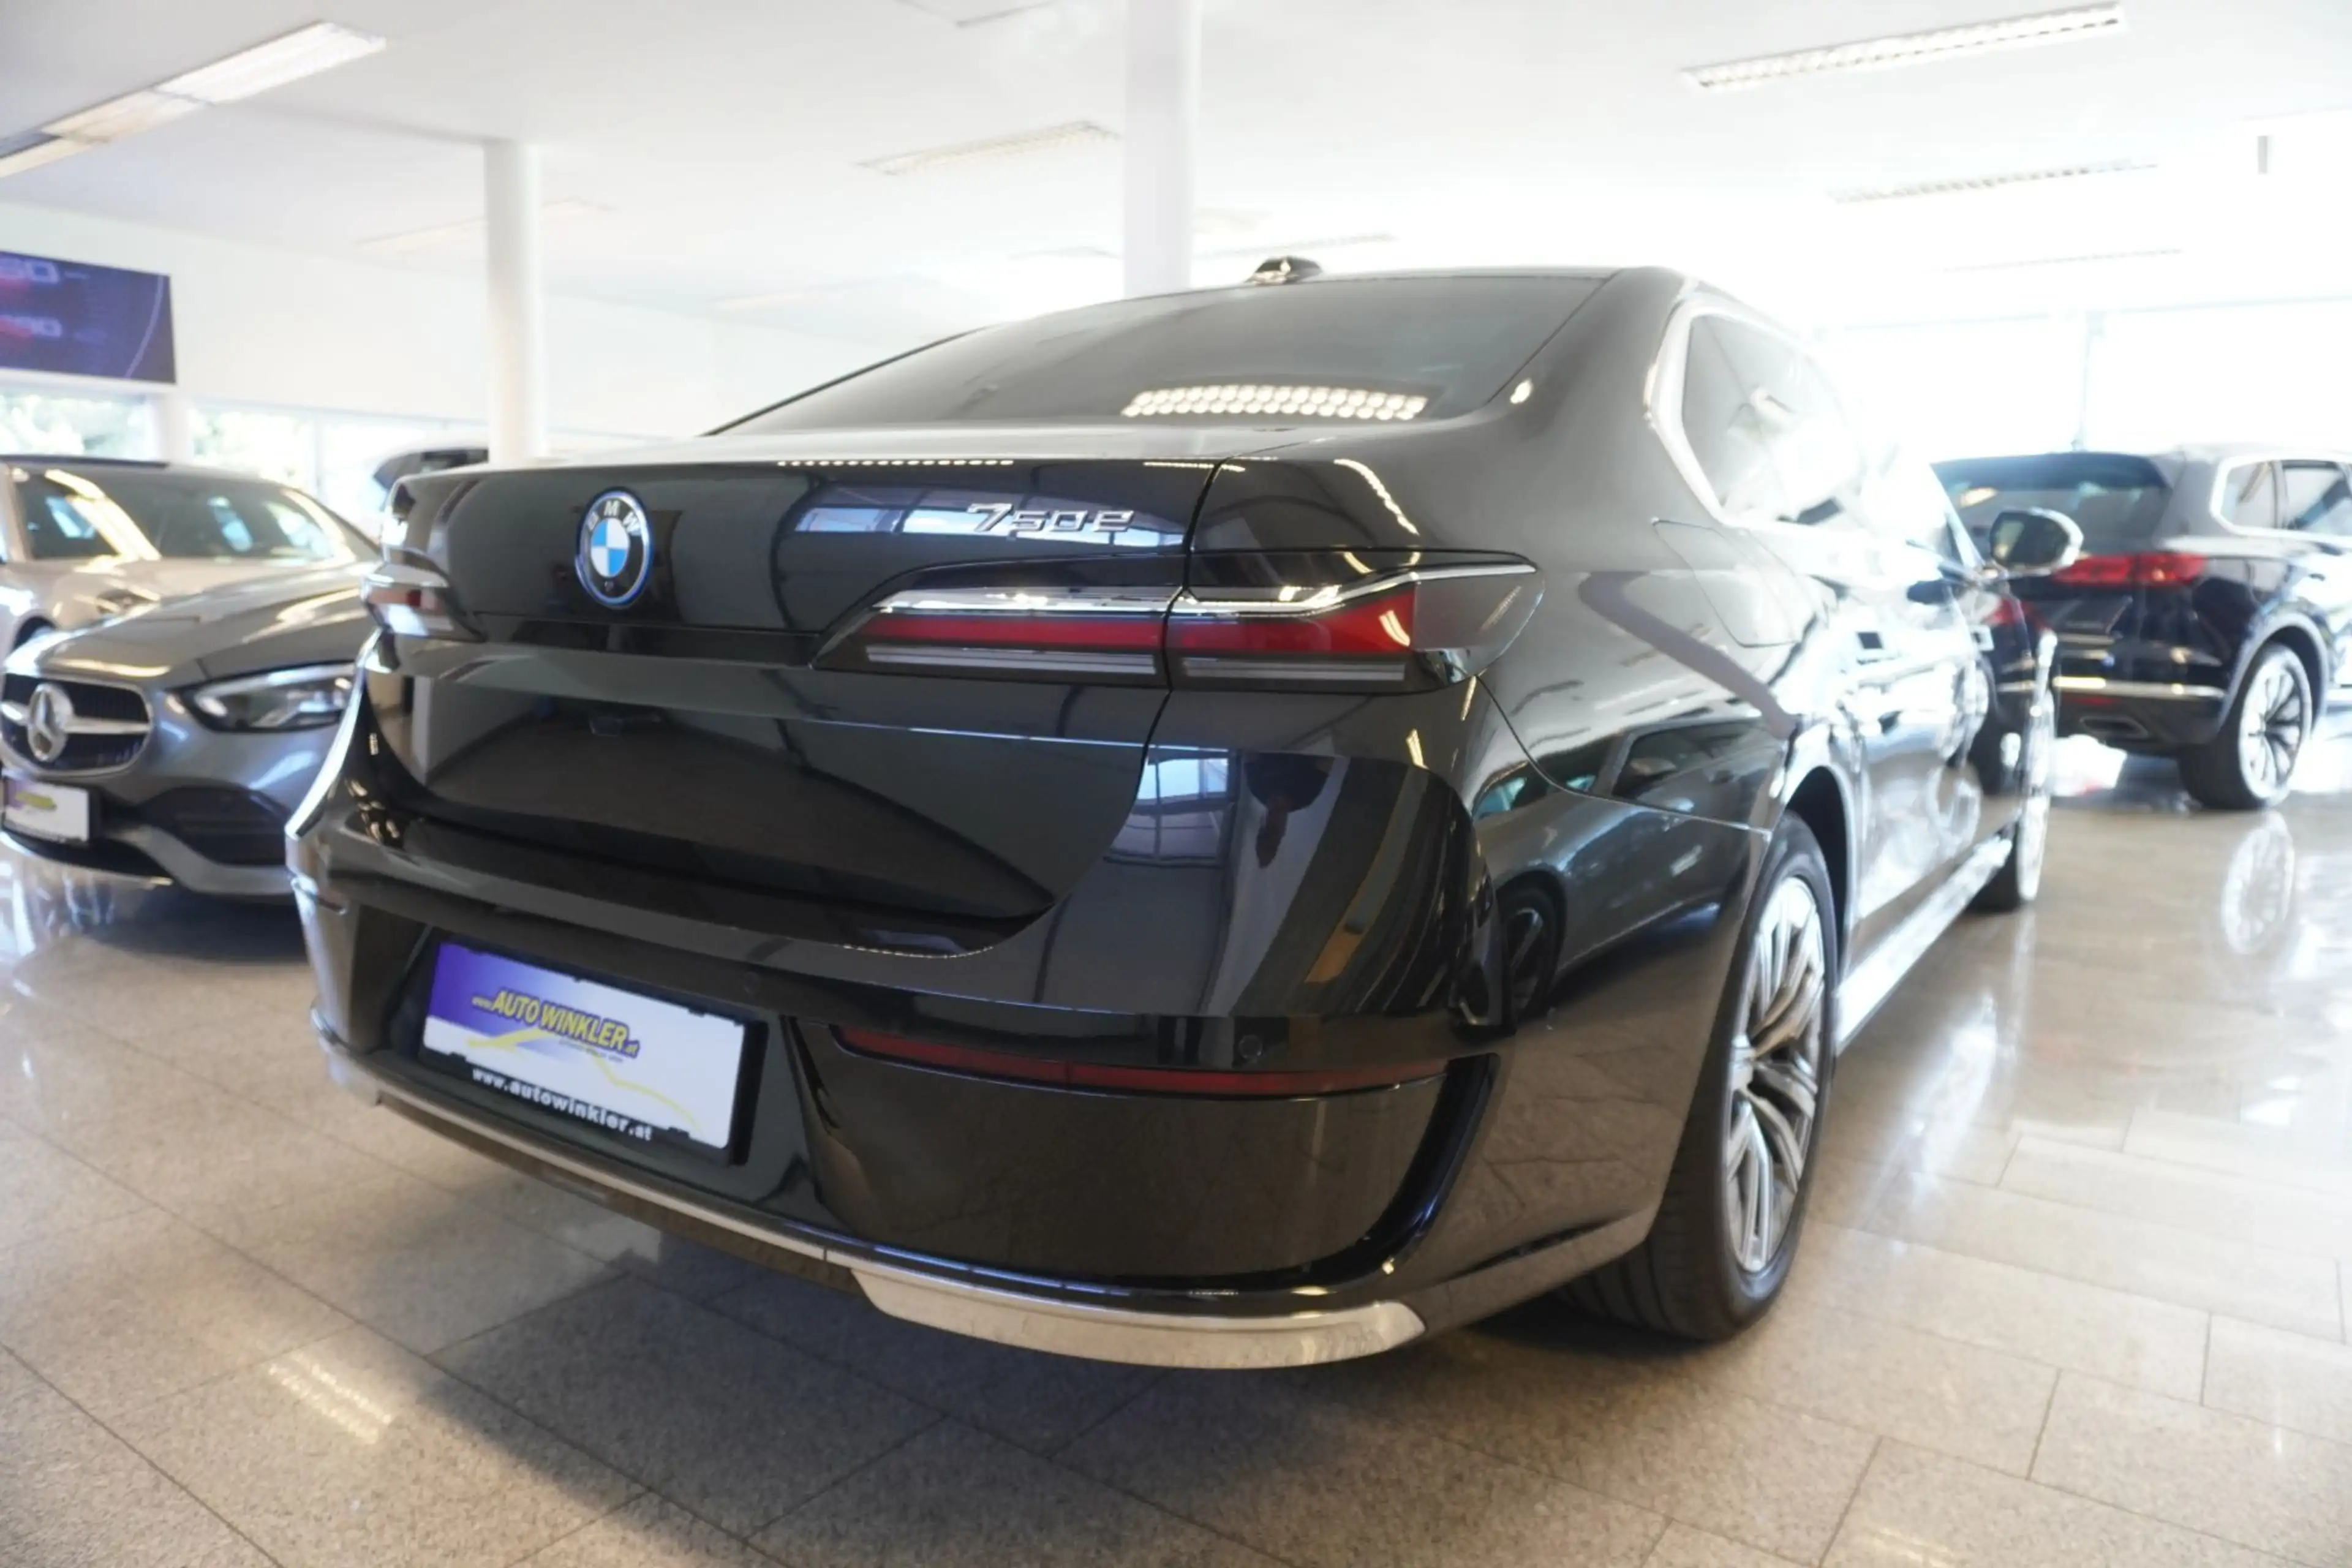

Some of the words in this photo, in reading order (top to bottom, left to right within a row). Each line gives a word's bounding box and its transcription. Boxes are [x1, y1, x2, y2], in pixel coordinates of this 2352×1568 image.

[586, 499, 641, 537] BMW
[967, 503, 1134, 532] 750e
[472, 1068, 652, 1141] www.autowinkler.at
